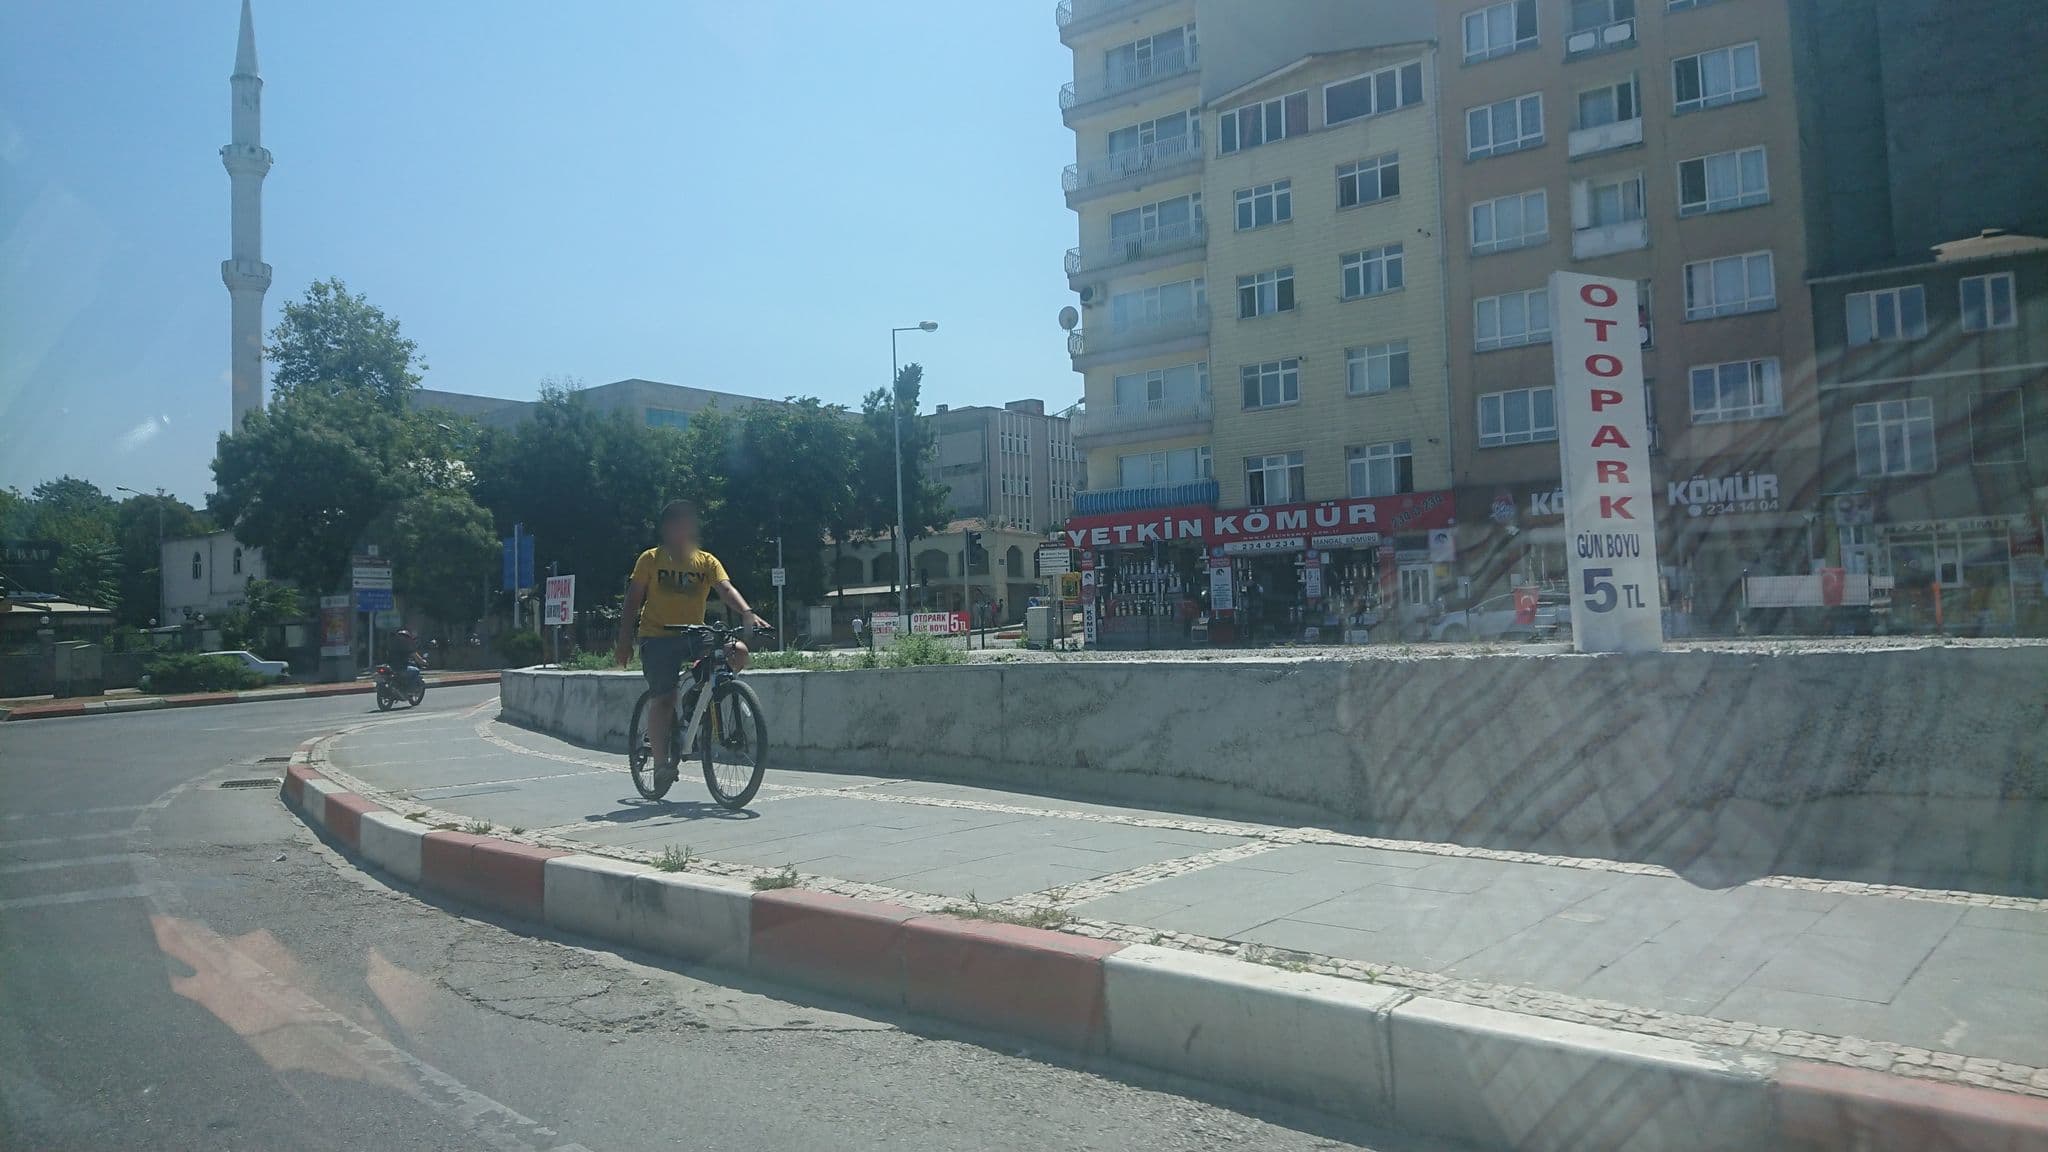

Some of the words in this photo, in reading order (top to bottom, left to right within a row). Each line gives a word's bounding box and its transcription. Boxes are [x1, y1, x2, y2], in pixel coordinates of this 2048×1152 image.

[1579, 283, 1636, 520] OTOPARK
[1667, 471, 1779, 506] KÖMÜR
[1530, 487, 1565, 516] KÖ
[1705, 502, 1732, 517] 234
[1739, 501, 1755, 513] 14
[1760, 499, 1779, 511] 04
[1067, 516, 1202, 548] YETKİN
[1214, 501, 1376, 535] KÖMÜR
[1275, 539, 1296, 548] 234
[1576, 530, 1603, 558] GÜN
[1607, 532, 1640, 557] BOYU
[547, 579, 571, 600] OTOPARK
[1582, 567, 1619, 614] 5
[1622, 583, 1646, 609] TL
[560, 600, 568, 622] 5
[913, 613, 946, 623] OTOPARK
[929, 623, 948, 633] BOYU
[949, 613, 959, 632] 5
[959, 620, 968, 631] TL
